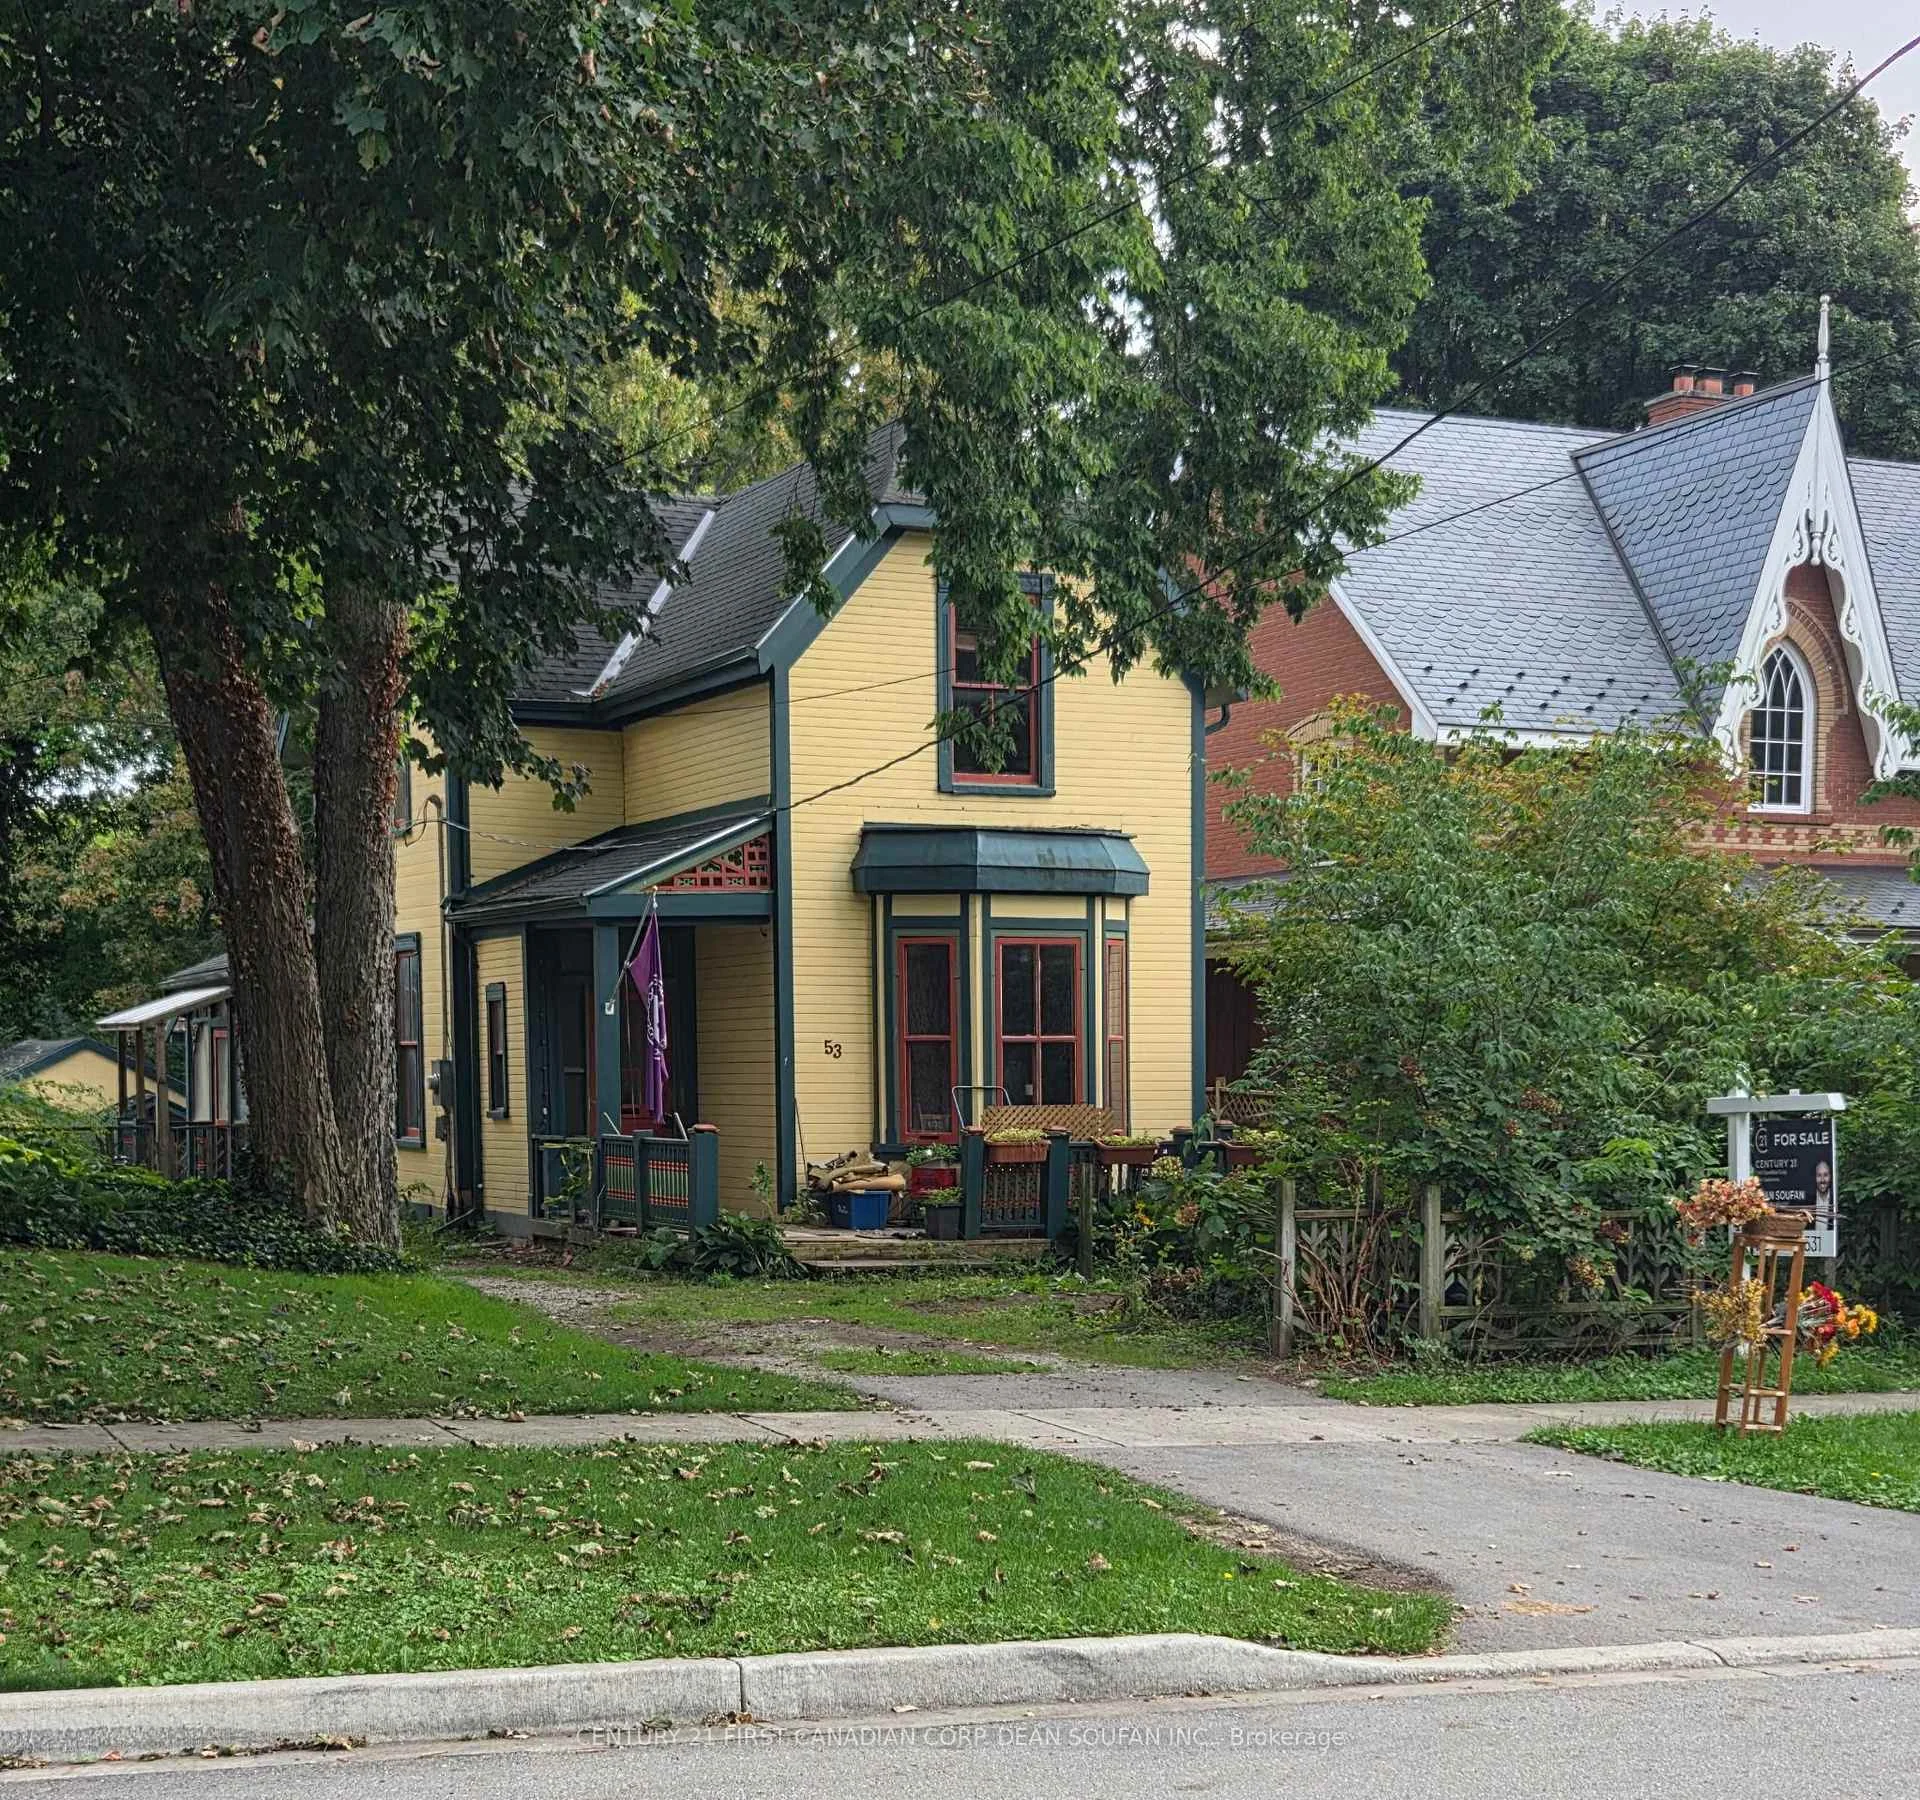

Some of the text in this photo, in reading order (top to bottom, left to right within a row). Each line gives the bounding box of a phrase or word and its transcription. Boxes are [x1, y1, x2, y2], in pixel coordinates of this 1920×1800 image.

[823, 1039, 845, 1059] 53
[1774, 1131, 1830, 1146] FOR SALE
[1755, 1158, 1798, 1169] CENTURY 21
[1775, 1190, 1805, 1200] SOUFAN
